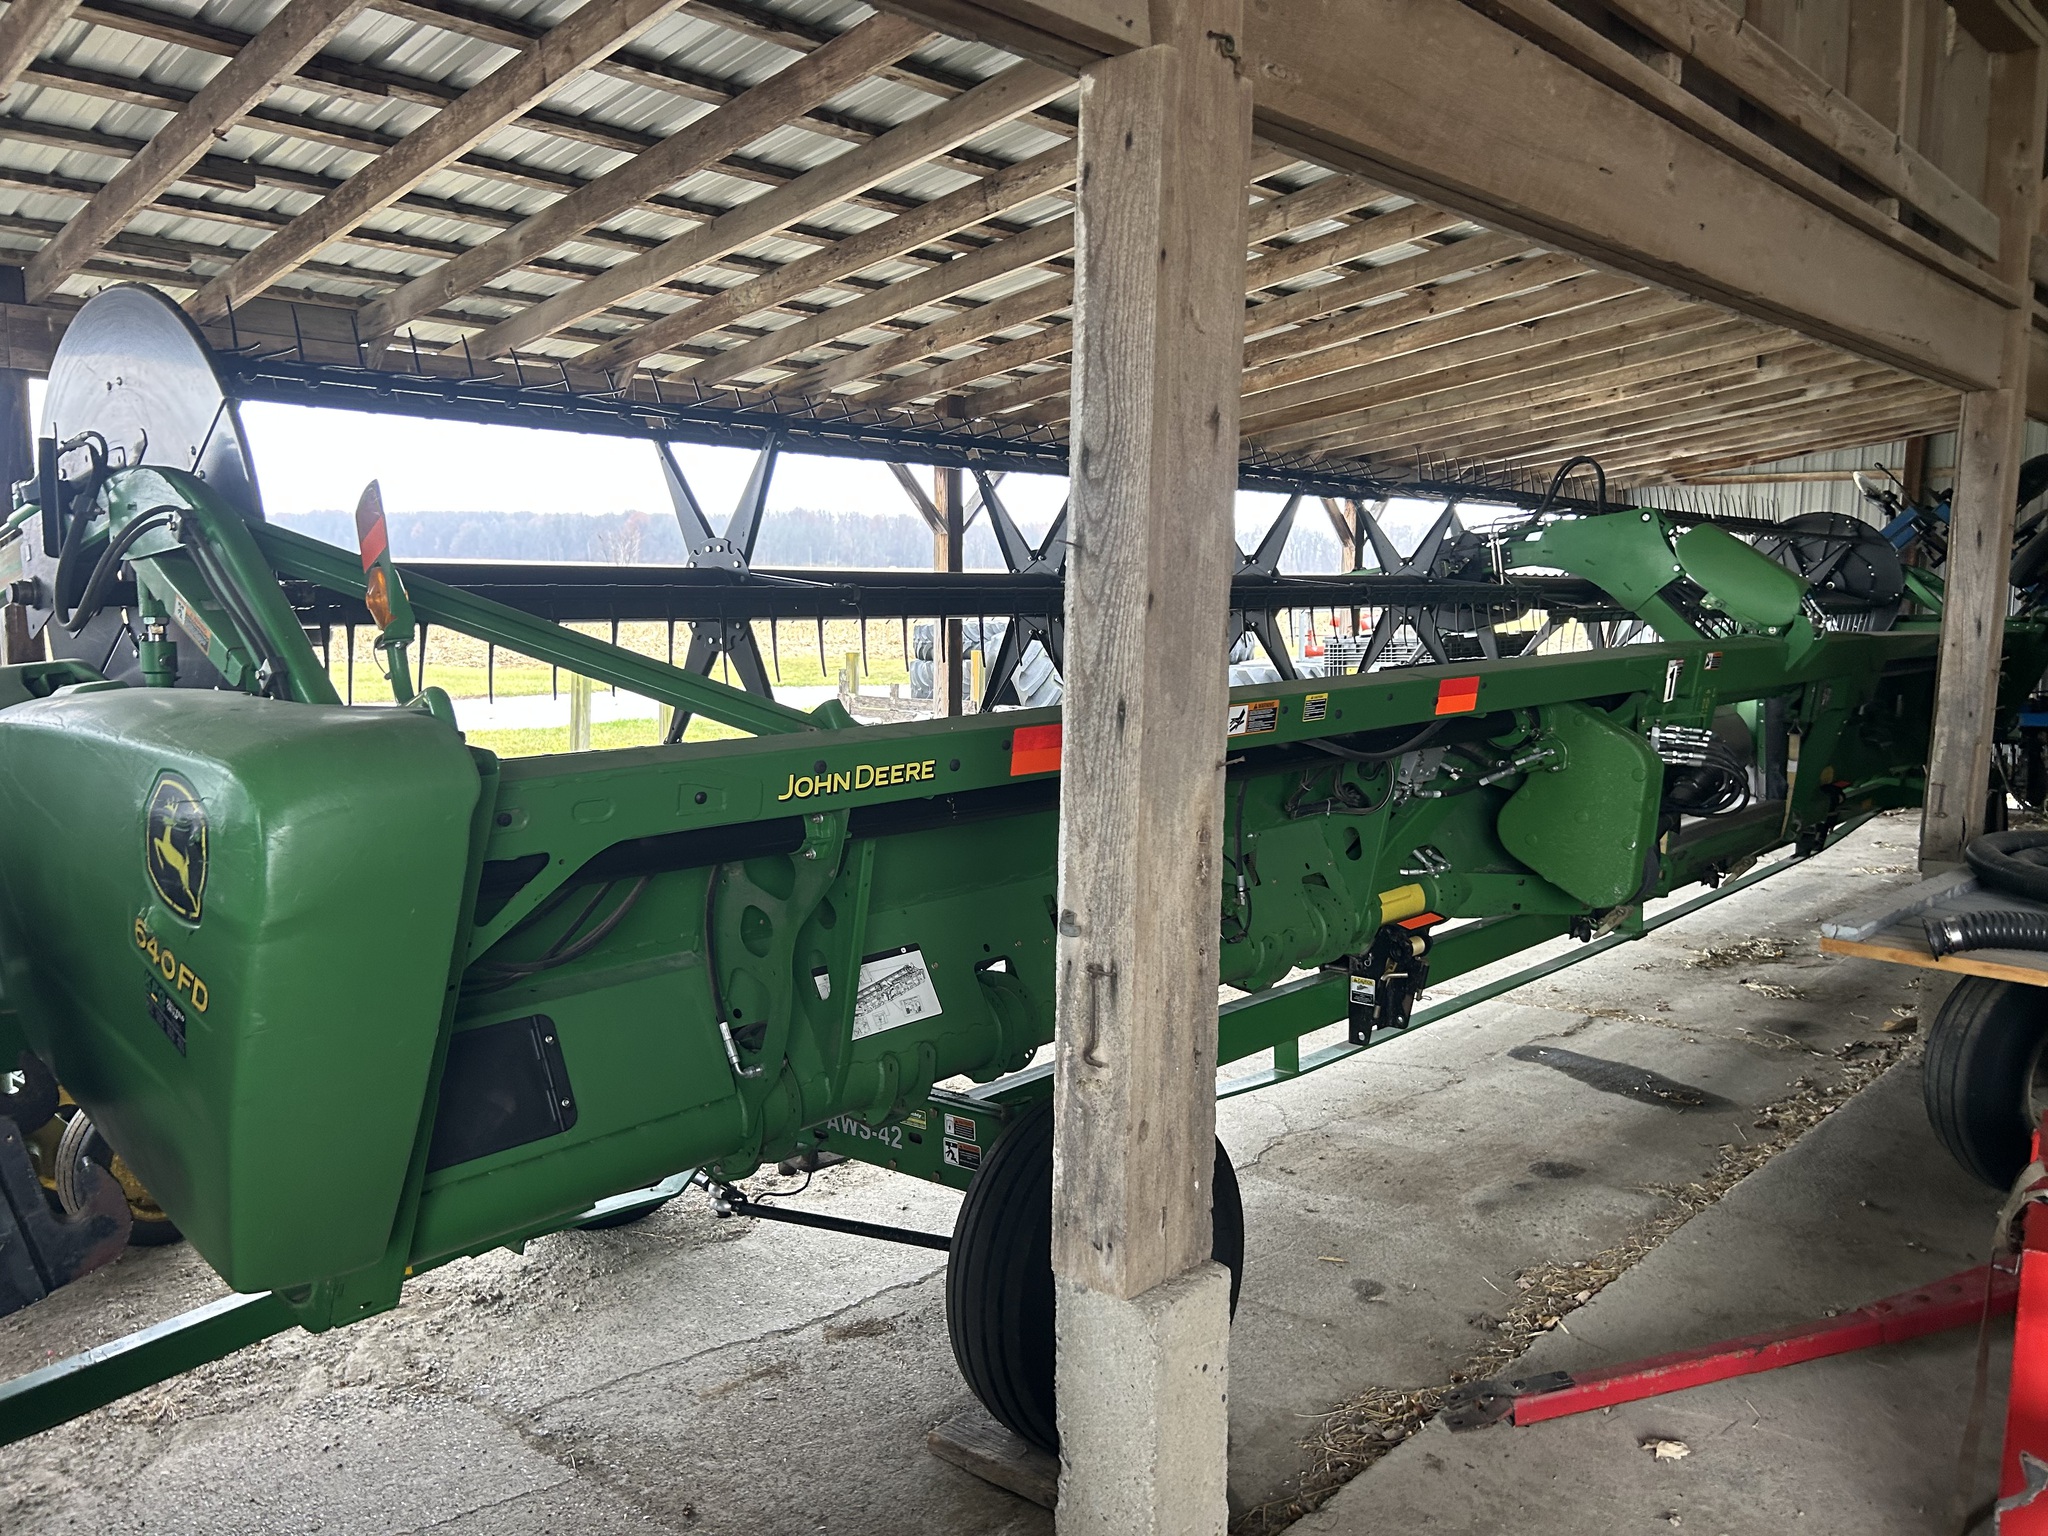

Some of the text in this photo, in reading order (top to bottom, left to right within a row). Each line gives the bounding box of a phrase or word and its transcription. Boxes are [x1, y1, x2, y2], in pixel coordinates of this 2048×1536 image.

[778, 759, 936, 801] JOHN DEERE
[134, 917, 210, 1014] 640FD
[827, 1115, 903, 1150] AWS-42
